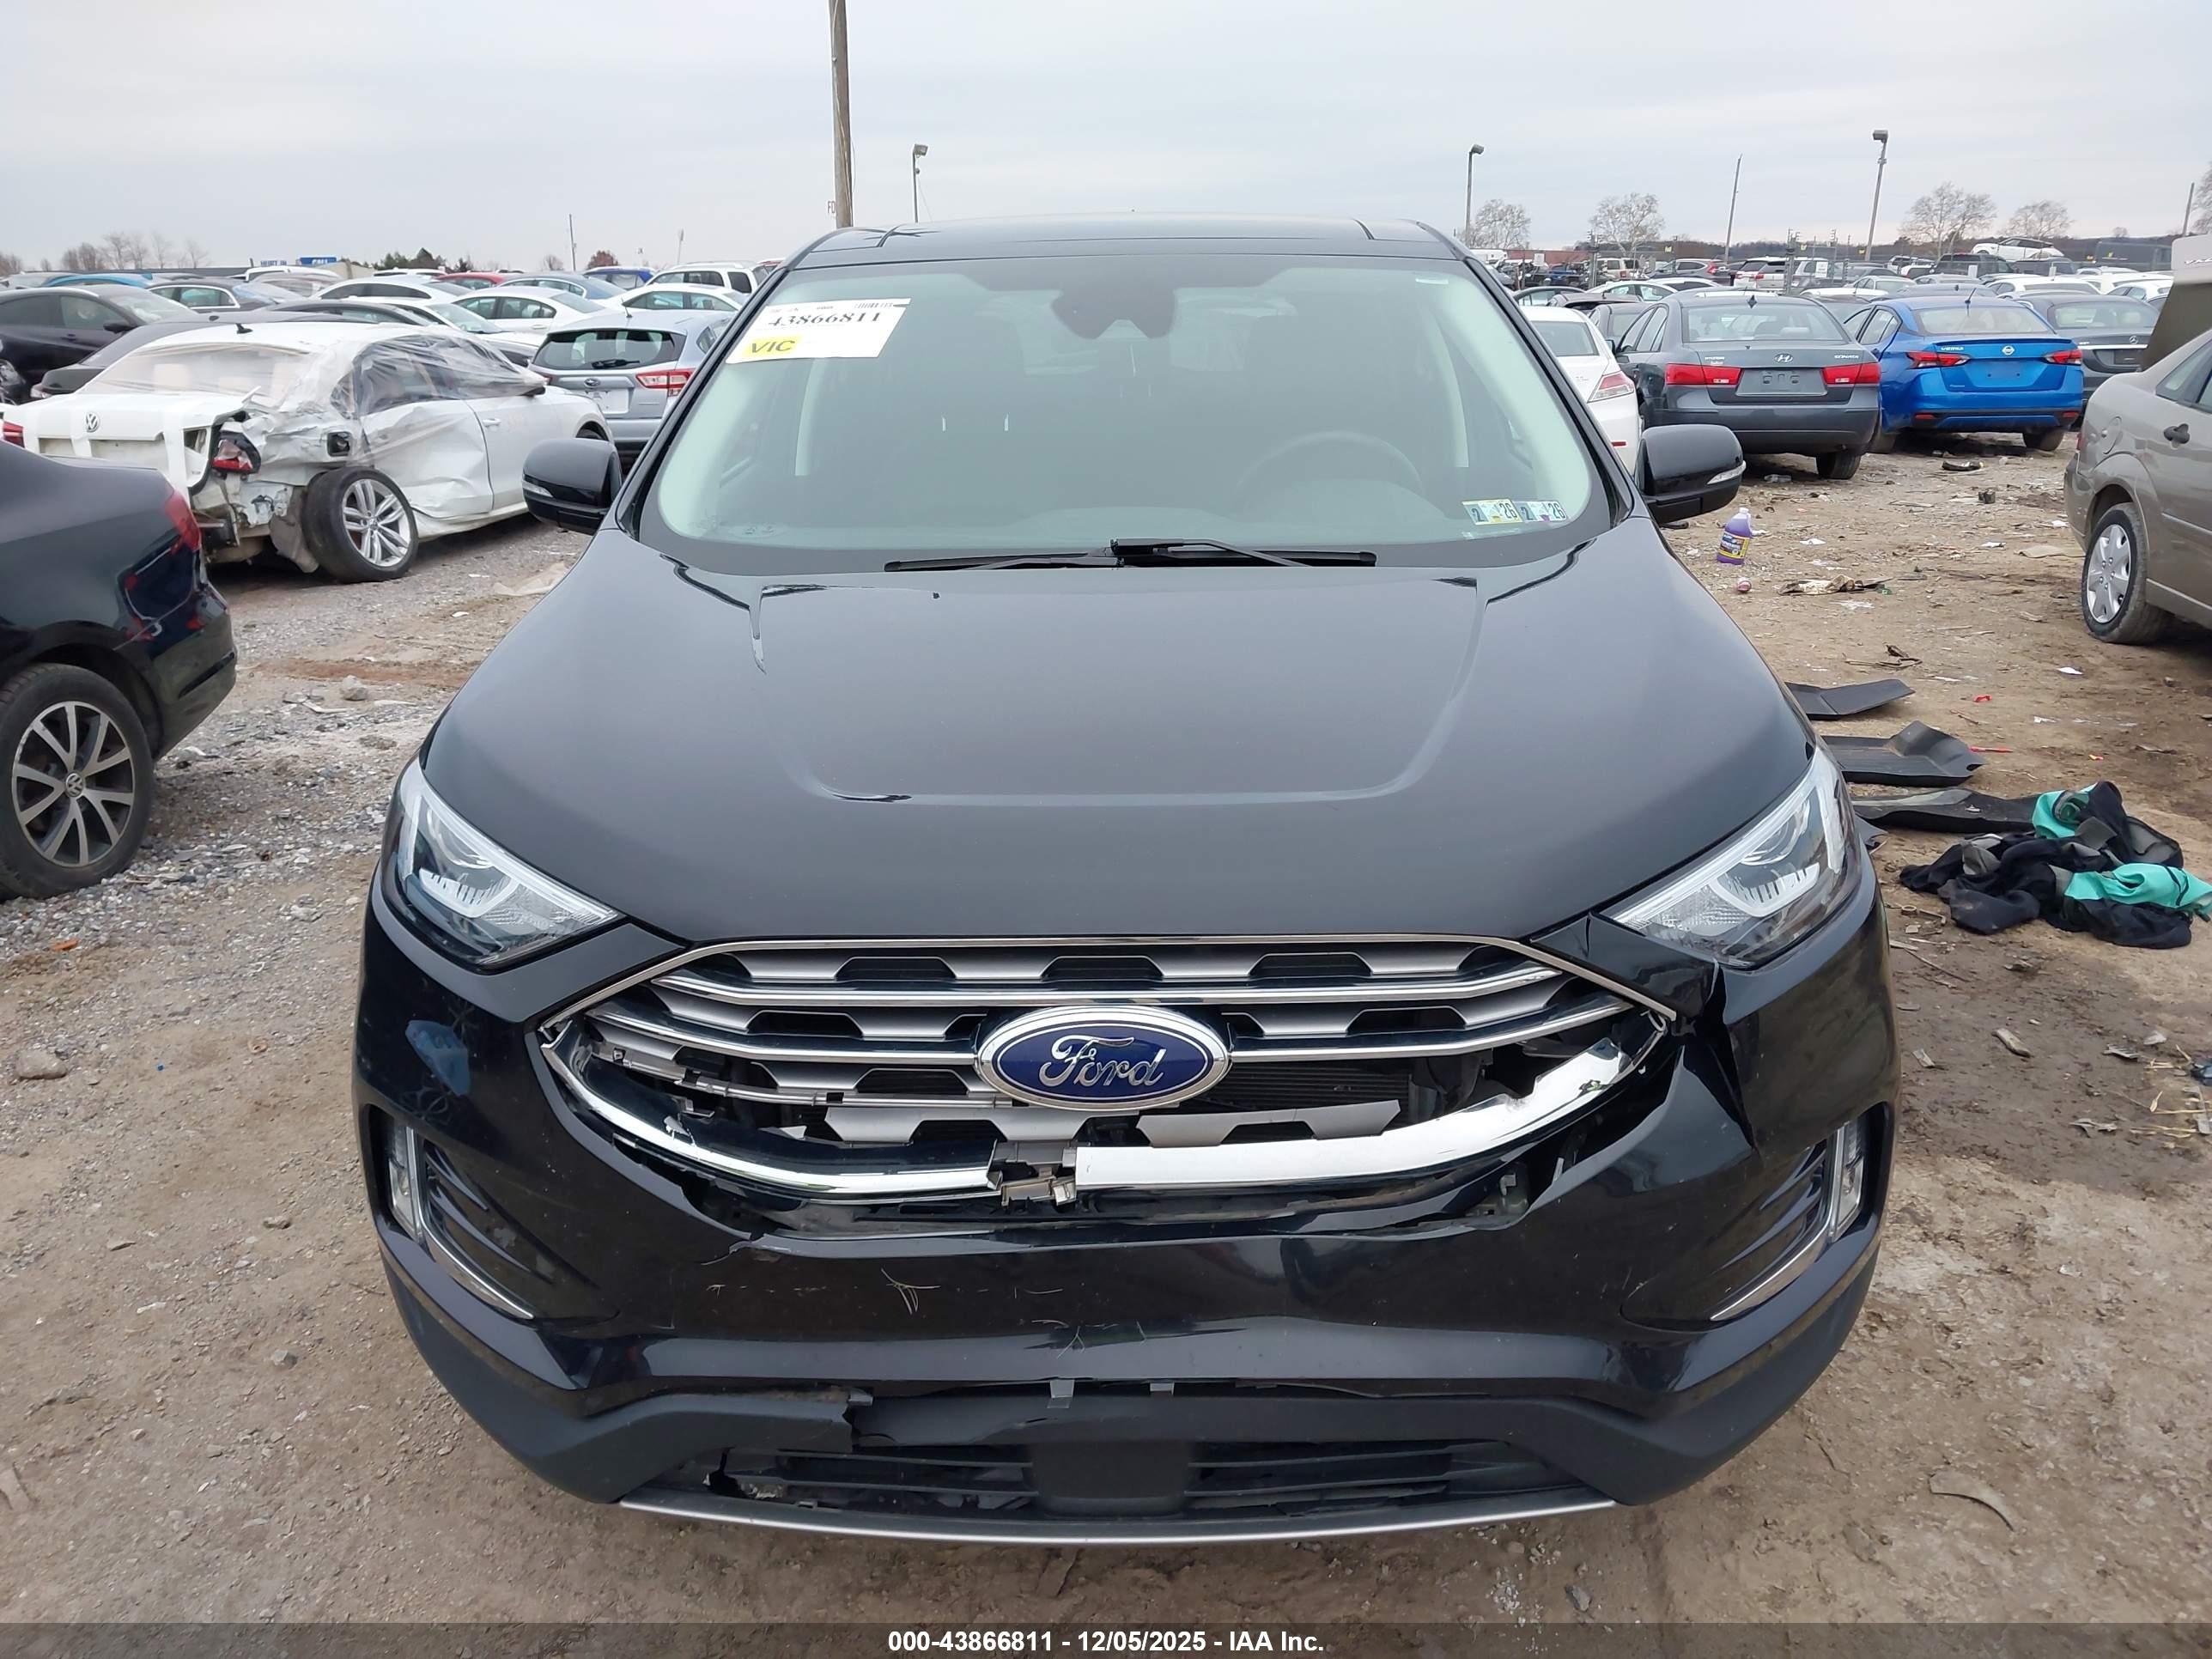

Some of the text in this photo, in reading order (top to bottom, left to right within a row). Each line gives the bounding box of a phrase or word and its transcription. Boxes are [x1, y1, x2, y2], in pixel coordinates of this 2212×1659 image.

[768, 311, 882, 327] 43866811
[750, 340, 795, 354] VIC
[1471, 502, 1517, 522] 2 26
[1521, 502, 1566, 521] 2 26
[1038, 1034, 1167, 1087] Ford
